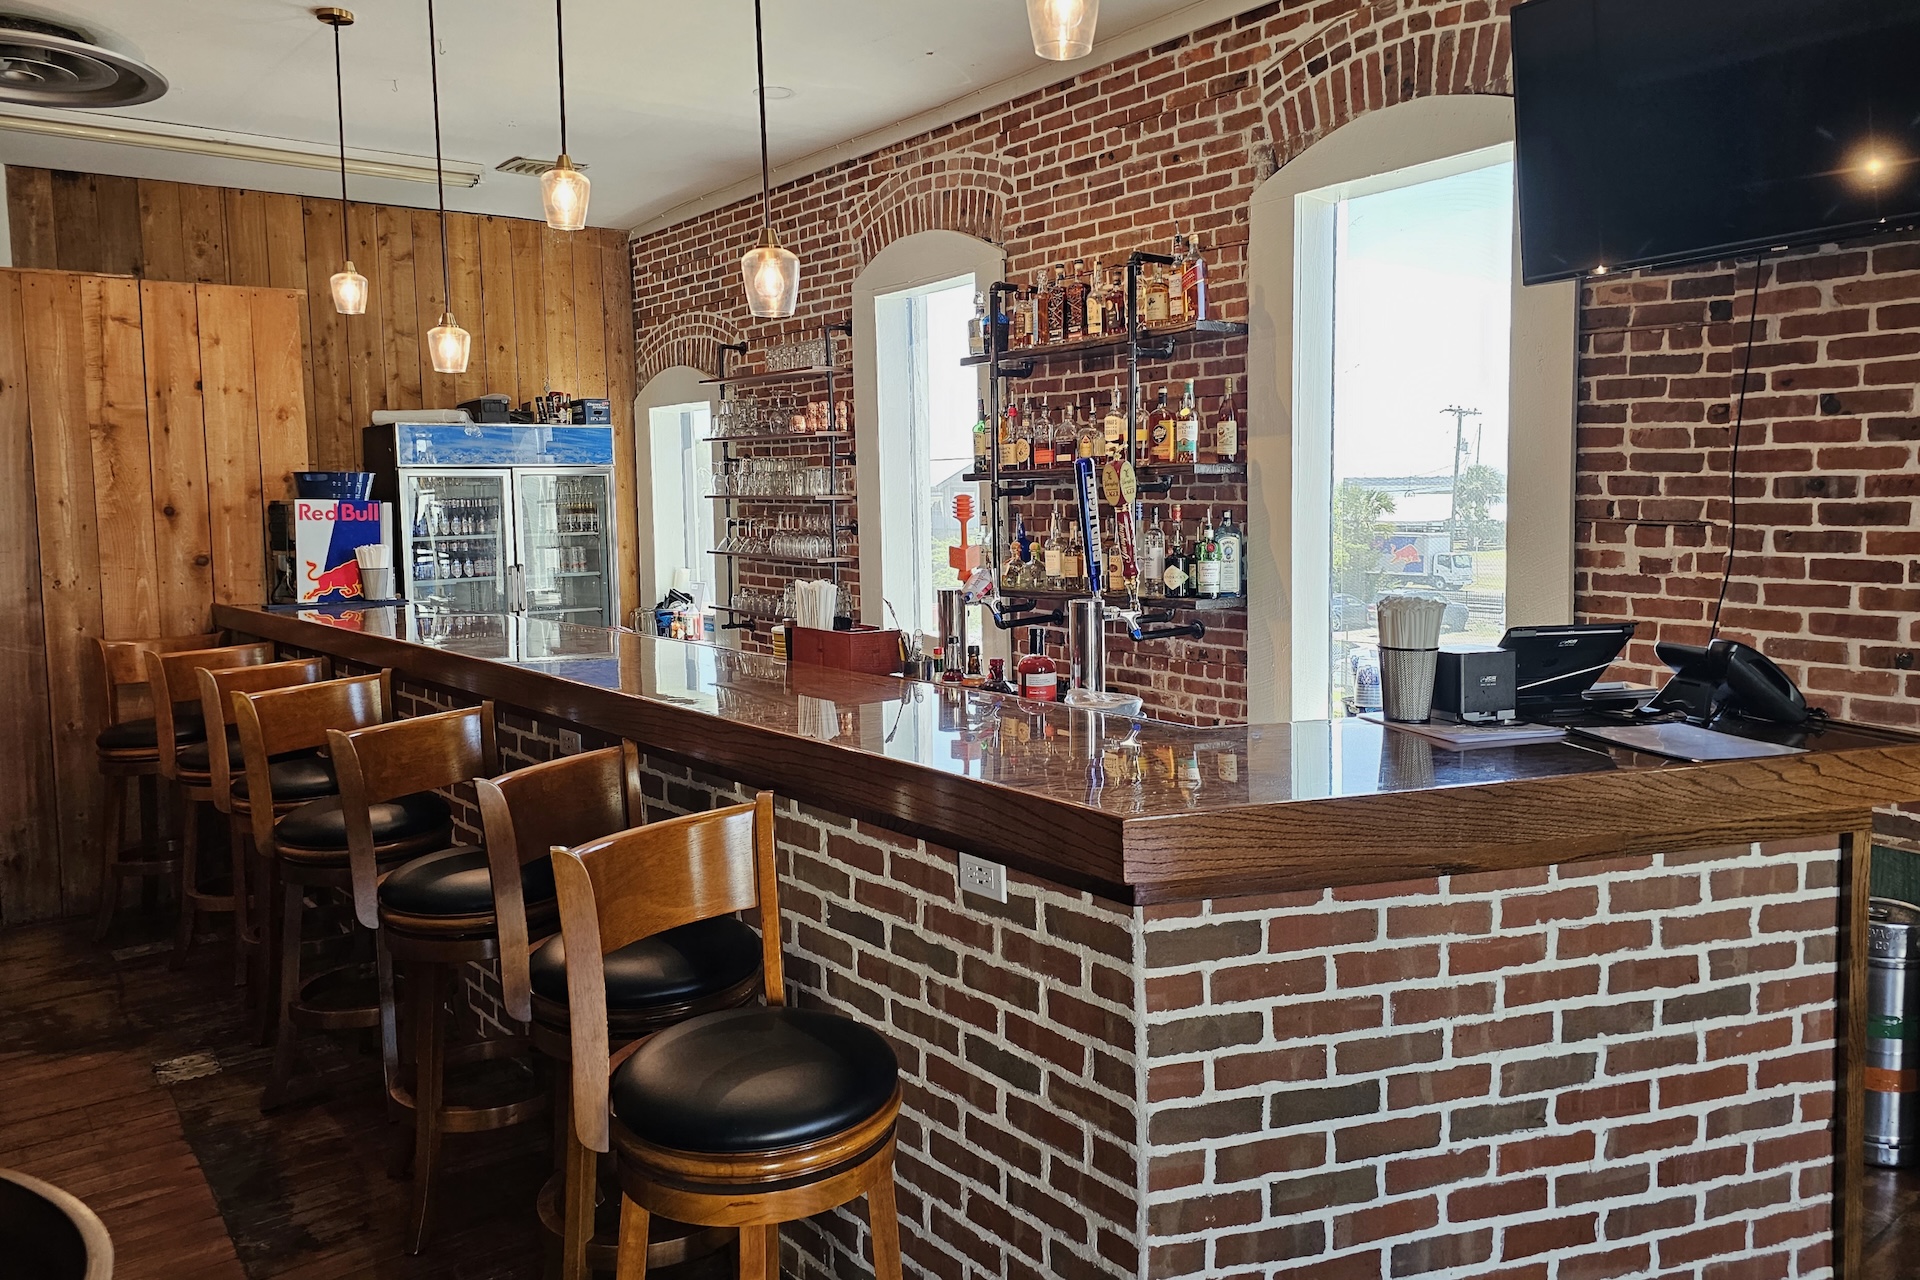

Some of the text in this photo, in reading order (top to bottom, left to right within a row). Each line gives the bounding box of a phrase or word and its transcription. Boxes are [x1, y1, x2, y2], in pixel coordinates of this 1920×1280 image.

[298, 503, 380, 521] Red Bull
[1086, 476, 1101, 562] BUD LIGHT
